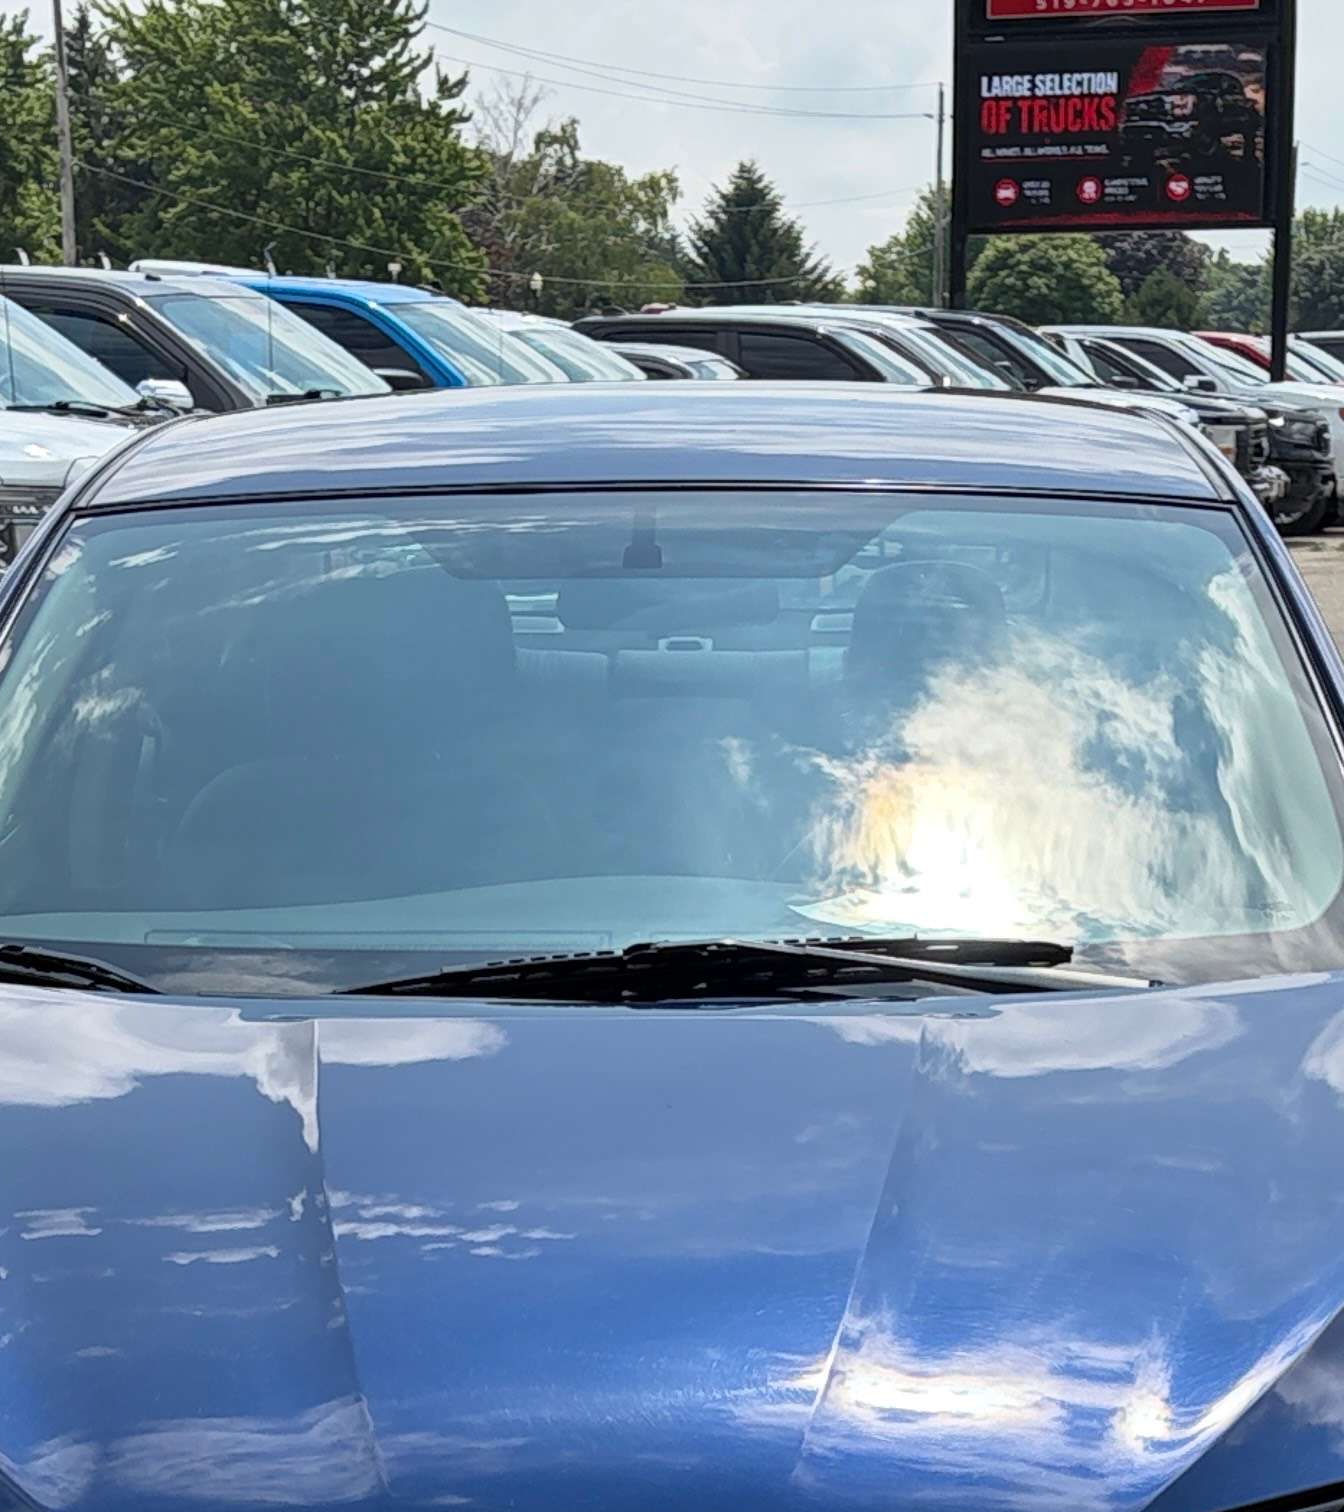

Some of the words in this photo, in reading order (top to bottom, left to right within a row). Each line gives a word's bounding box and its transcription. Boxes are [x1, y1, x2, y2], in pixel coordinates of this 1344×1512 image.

[980, 75, 1033, 98] LARGE
[1035, 72, 1118, 96] SELECTION
[981, 99, 1012, 135] OF
[1017, 96, 1116, 134] TRUCKS
